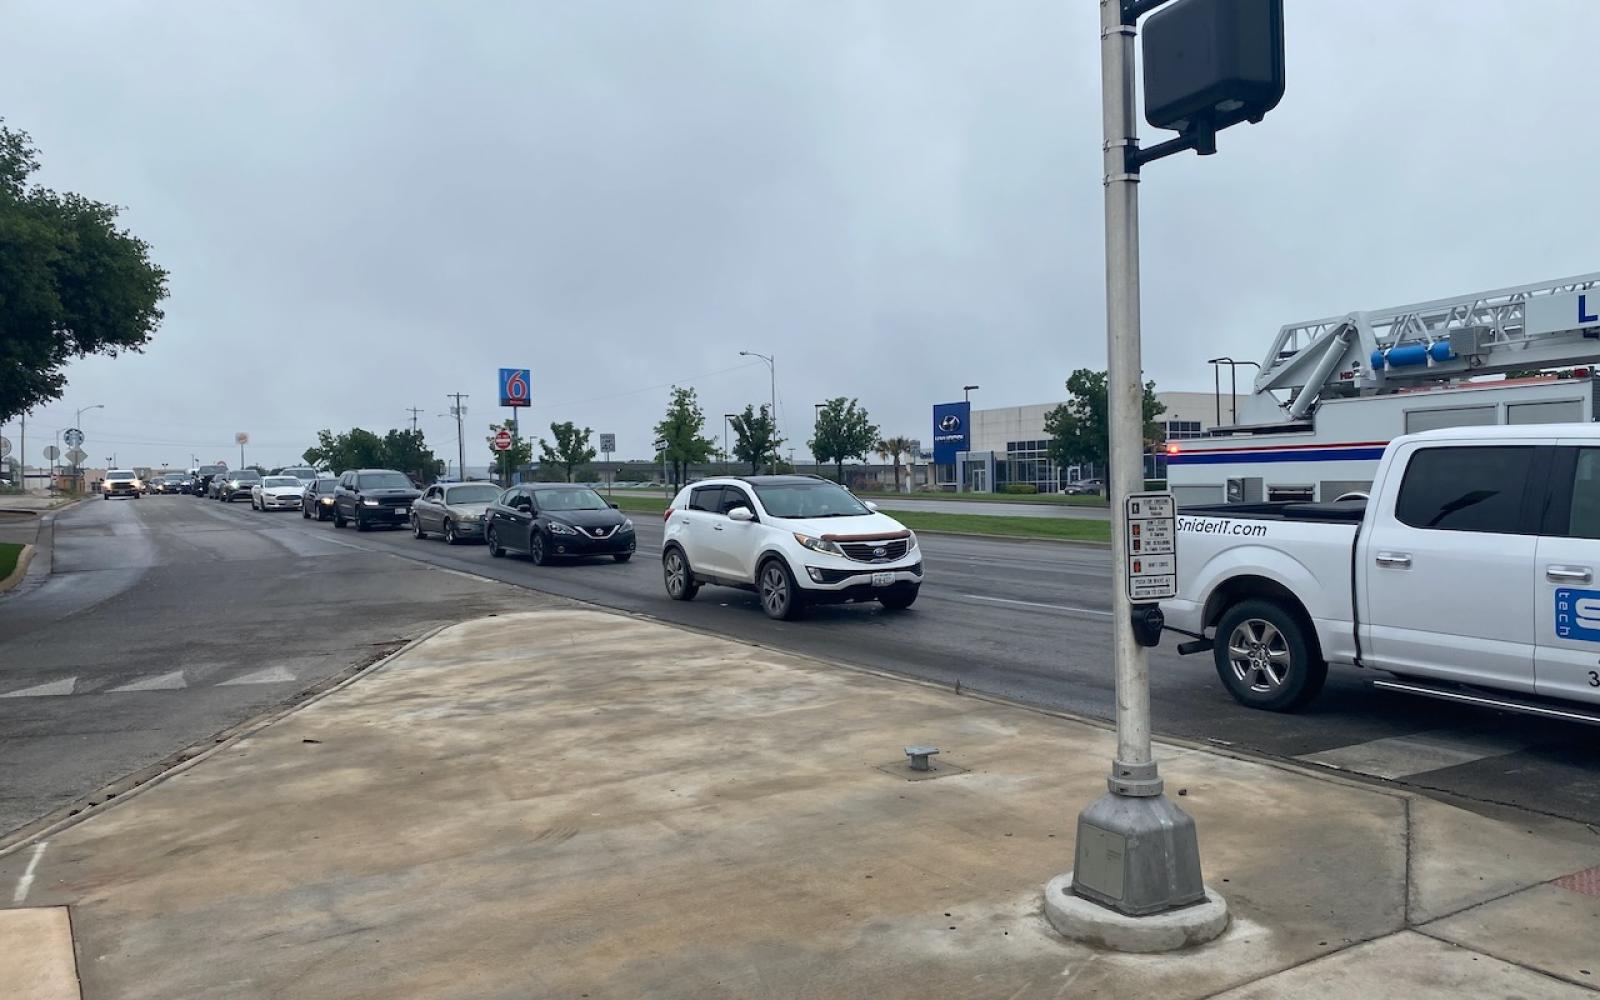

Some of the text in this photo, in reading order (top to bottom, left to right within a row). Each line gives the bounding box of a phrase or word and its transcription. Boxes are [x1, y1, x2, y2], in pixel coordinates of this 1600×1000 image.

[506, 370, 528, 402] 6
[1177, 518, 1267, 537] SniderIT.com
[1558, 591, 1571, 636] tech
